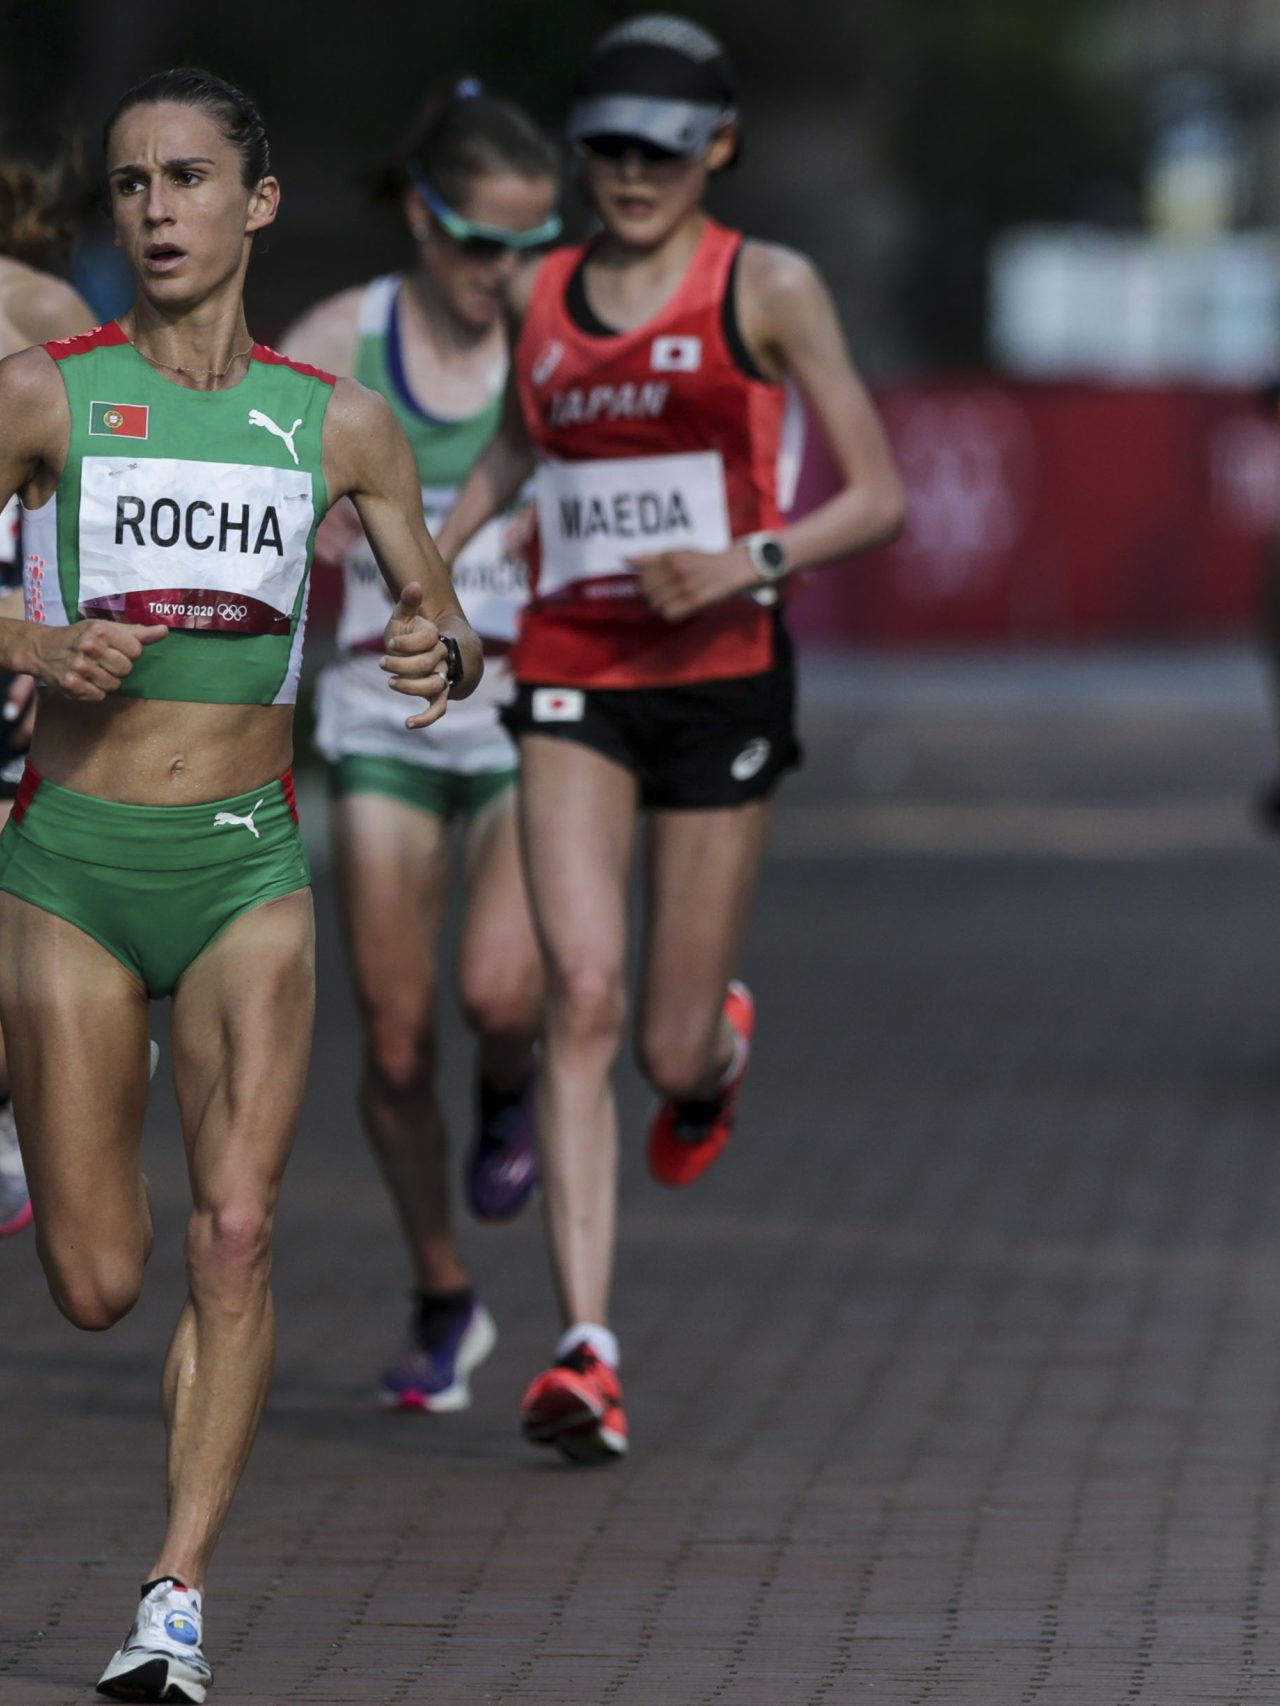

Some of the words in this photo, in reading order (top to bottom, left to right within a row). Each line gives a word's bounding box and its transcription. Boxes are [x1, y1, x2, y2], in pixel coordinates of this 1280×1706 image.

[549, 382, 669, 427] JAPAN
[114, 495, 284, 557] ROCHA
[558, 488, 690, 539] MAEDA
[149, 602, 185, 615] TOKYO
[186, 604, 214, 617] 2020
